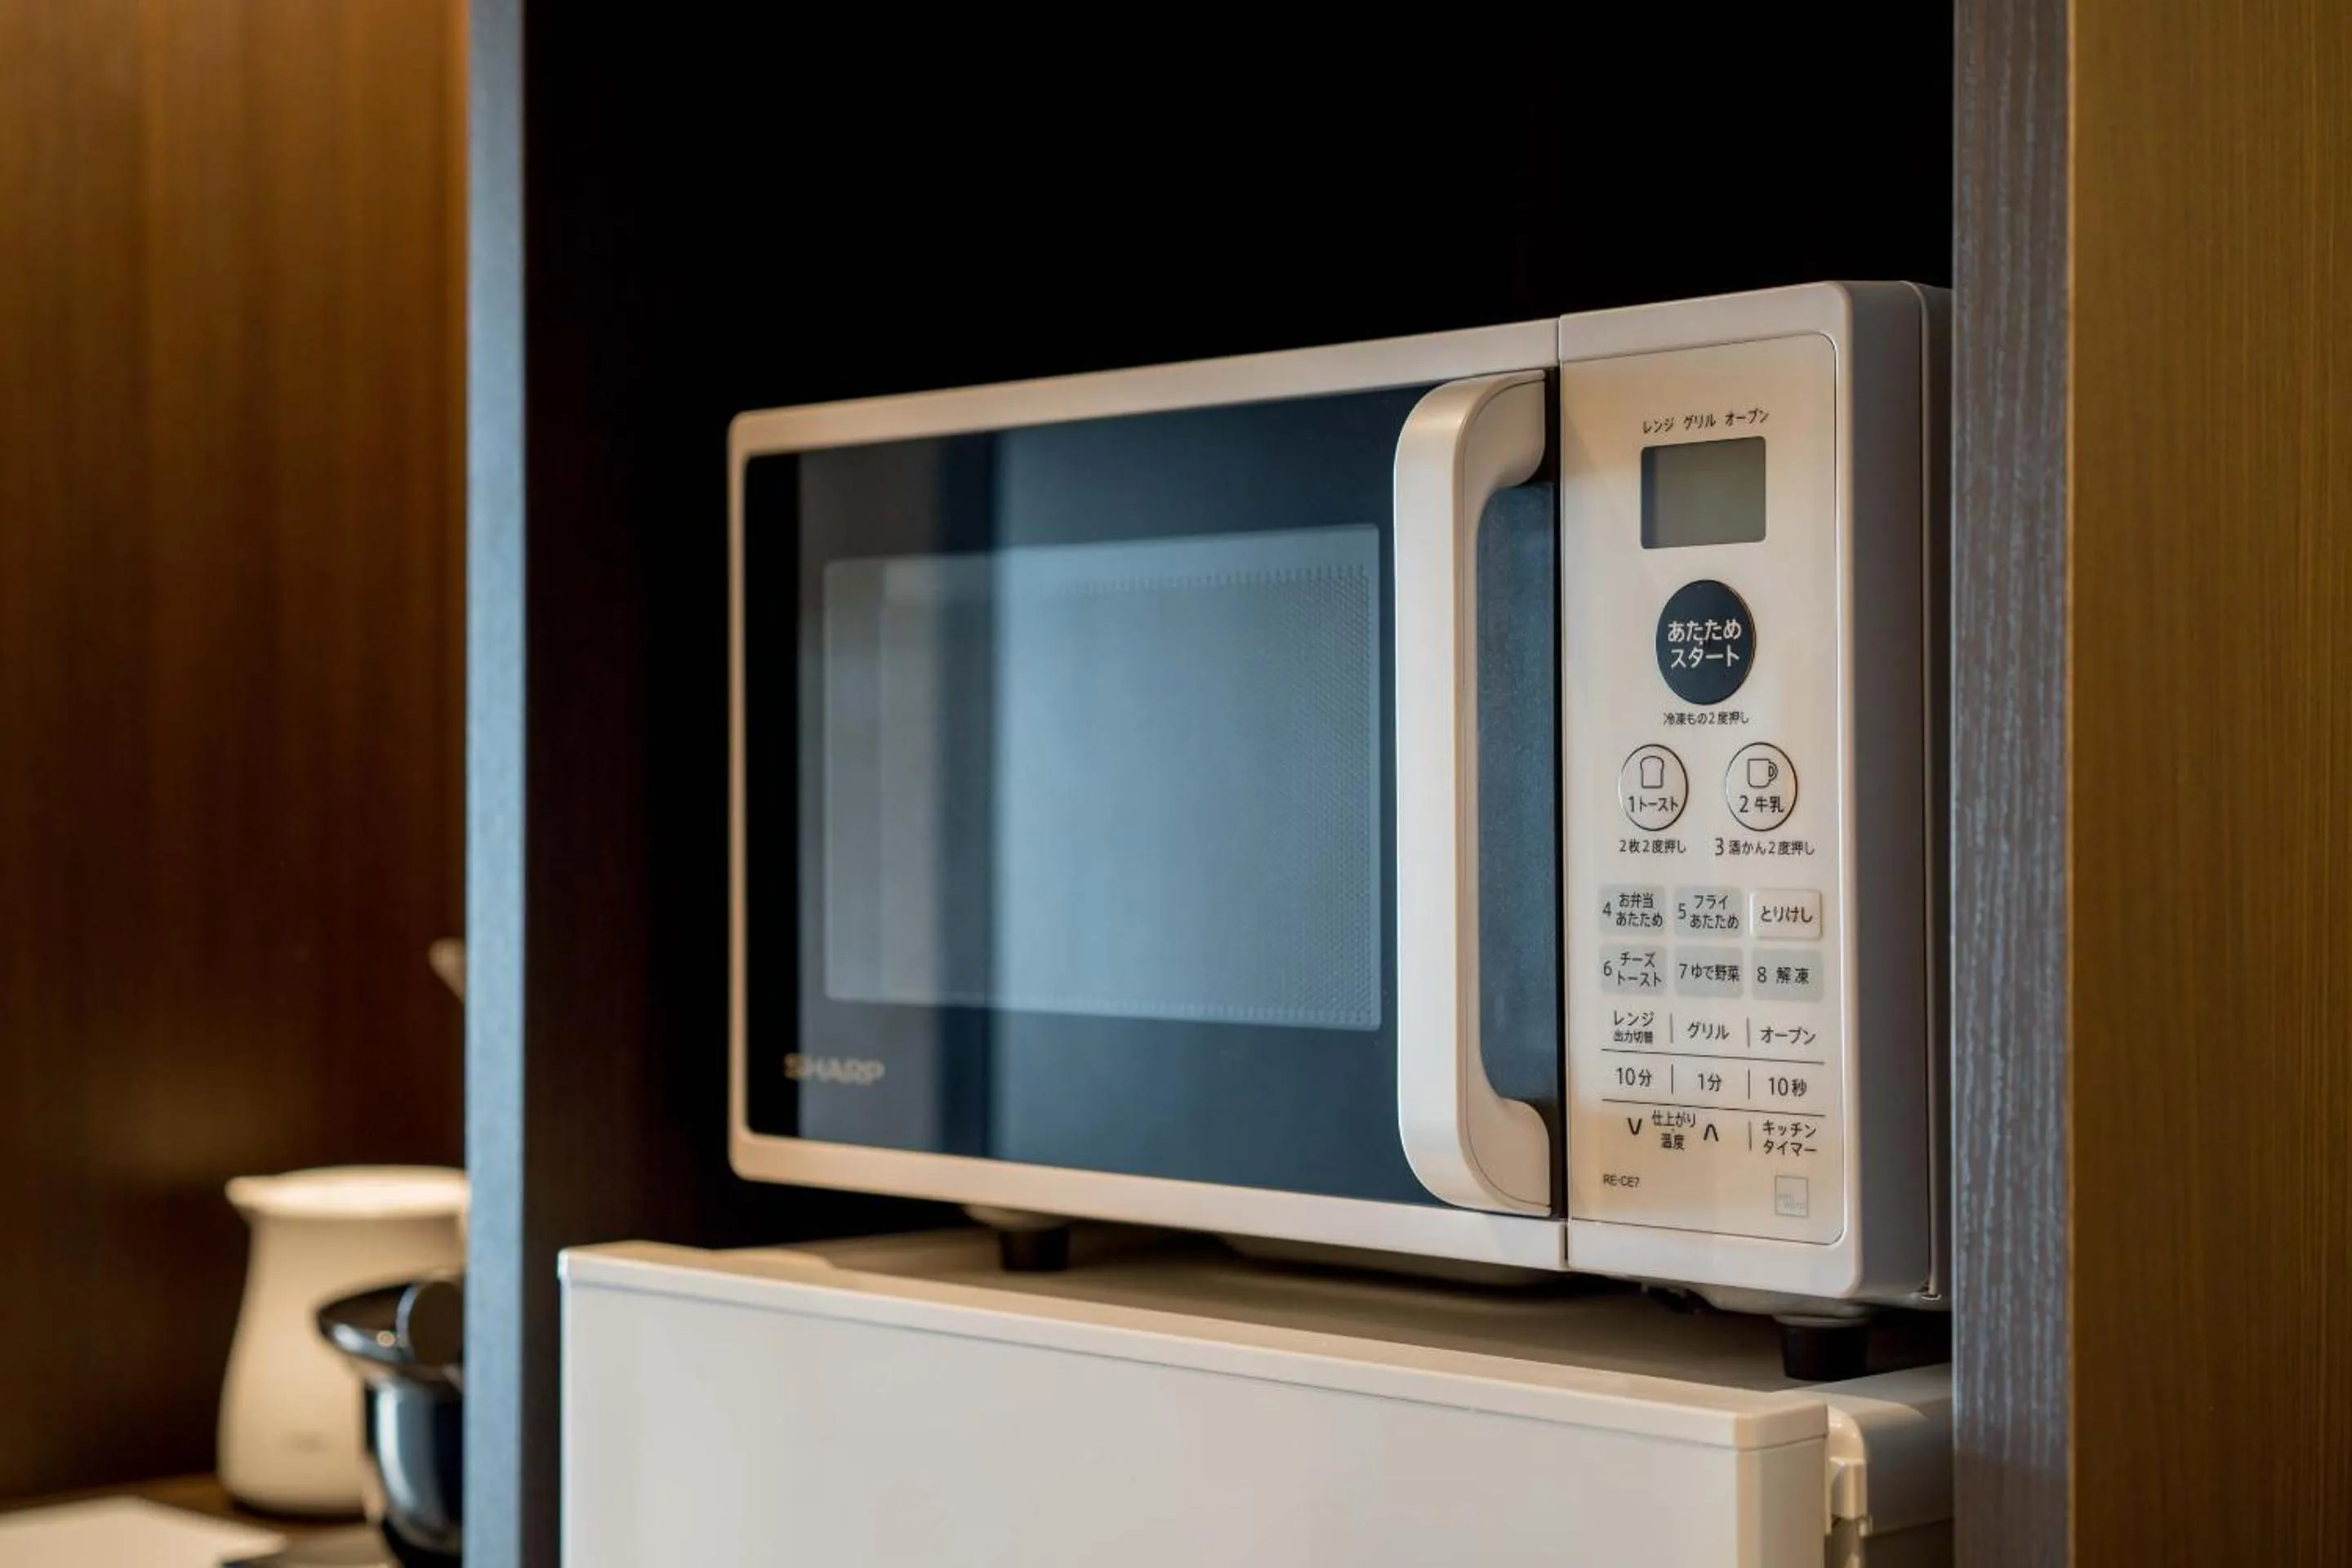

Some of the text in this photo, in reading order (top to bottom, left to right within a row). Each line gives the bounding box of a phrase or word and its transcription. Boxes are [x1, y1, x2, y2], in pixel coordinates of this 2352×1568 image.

[1642, 408, 1770, 434] レンジ グリル オーブン
[1668, 619, 1742, 643] あたため
[1670, 644, 1740, 669] スタート
[1663, 711, 1749, 726] 冷凍もの2度押し
[1755, 795, 1784, 813] 牛乳
[1619, 839, 1686, 853] 2枚2度押し
[1619, 892, 1655, 909] お弁当
[1694, 894, 1729, 909] フライ
[1602, 902, 1611, 917] 4
[1678, 903, 1686, 920] 5
[1760, 905, 1813, 924] とりけし
[1616, 912, 1663, 927] あたため
[1690, 914, 1739, 929] あたため
[1620, 951, 1656, 968] チーズ
[1603, 960, 1612, 977] 6
[1757, 967, 1810, 985] 8 解凍
[1617, 970, 1662, 987] トースト
[1613, 1010, 1655, 1027] レンジ
[1613, 1031, 1653, 1045] 出力切替
[1688, 1022, 1730, 1040] グリル
[1761, 1026, 1816, 1045] オーブン
[783, 1052, 887, 1086] SHARP
[1617, 1067, 1652, 1087] 10分
[1698, 1072, 1722, 1092] 1分
[1768, 1077, 1807, 1097] 10秒
[1652, 1110, 1696, 1128] 仕上がり
[1762, 1120, 1816, 1138] キッチン
[1660, 1133, 1685, 1151] 温度
[1763, 1140, 1816, 1157] タイマー
[1603, 1174, 1640, 1188] RE-CE7
